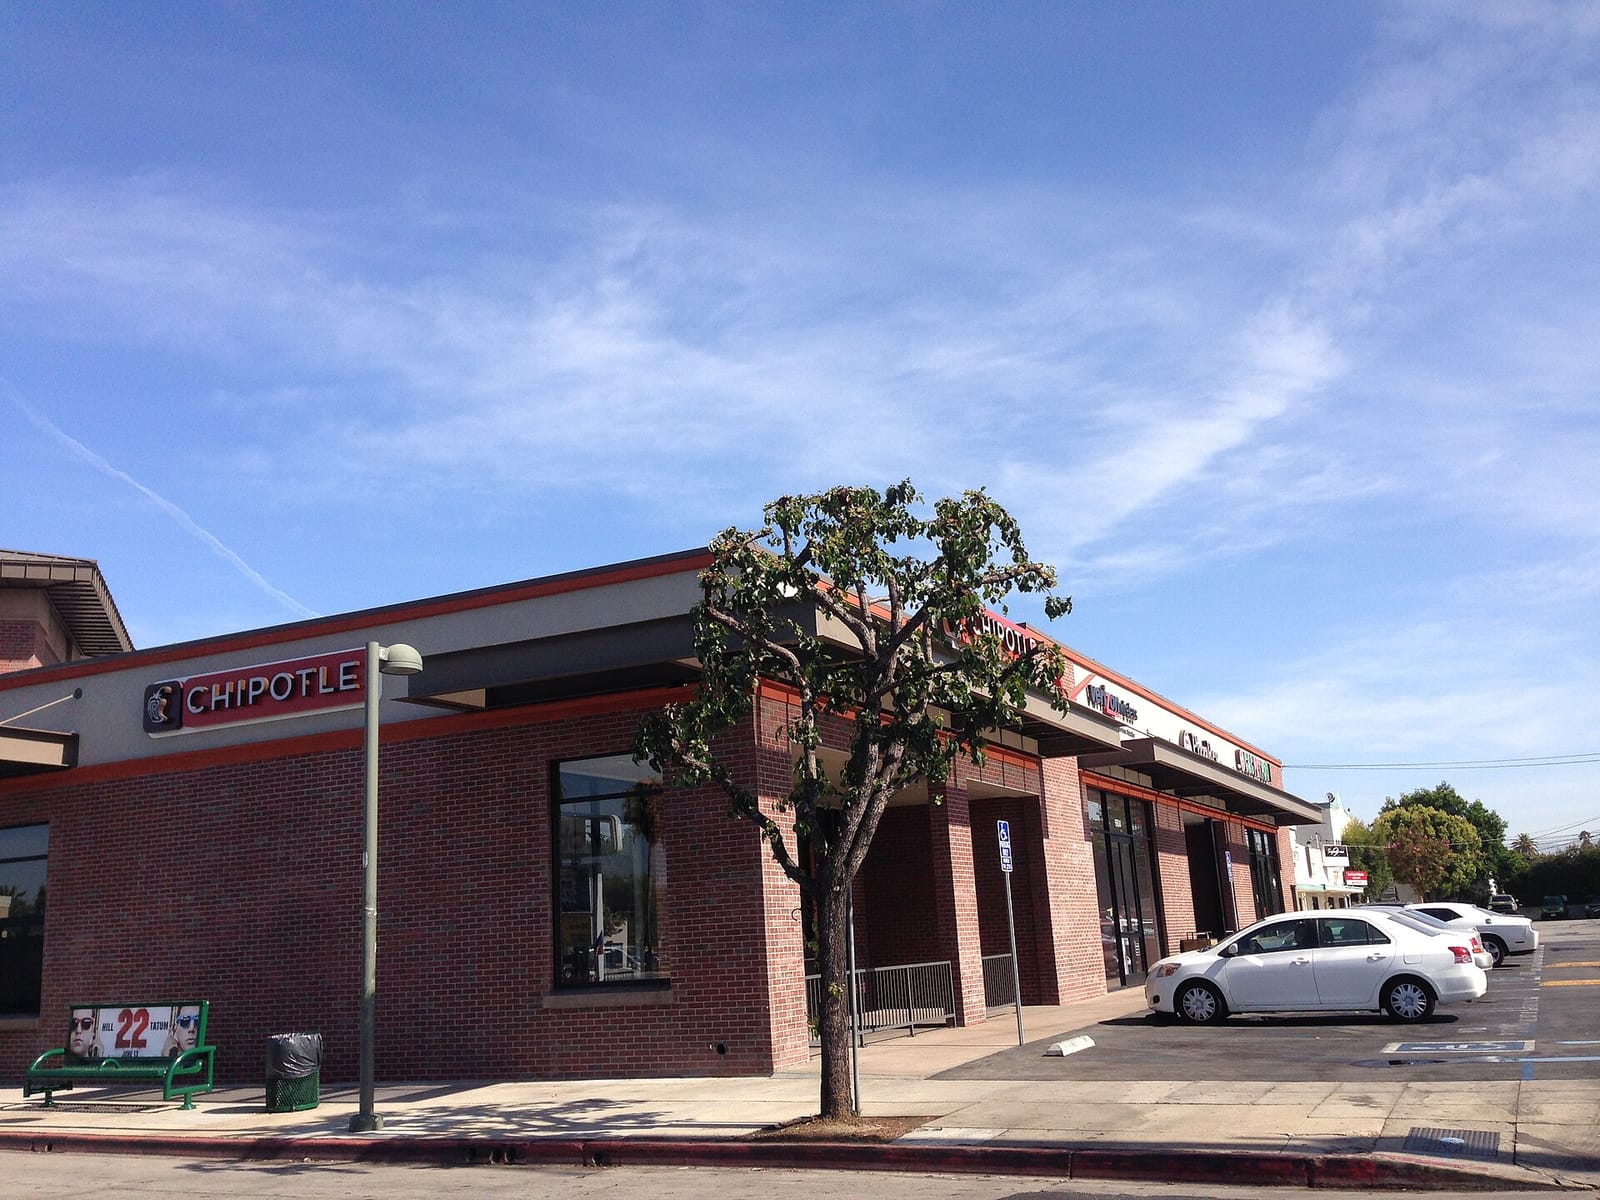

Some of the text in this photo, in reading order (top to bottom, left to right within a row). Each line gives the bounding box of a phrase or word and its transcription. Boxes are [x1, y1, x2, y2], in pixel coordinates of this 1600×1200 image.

[187, 660, 361, 714] CHIPOTLE
[102, 1008, 169, 1049] HILL 22 TATUM
